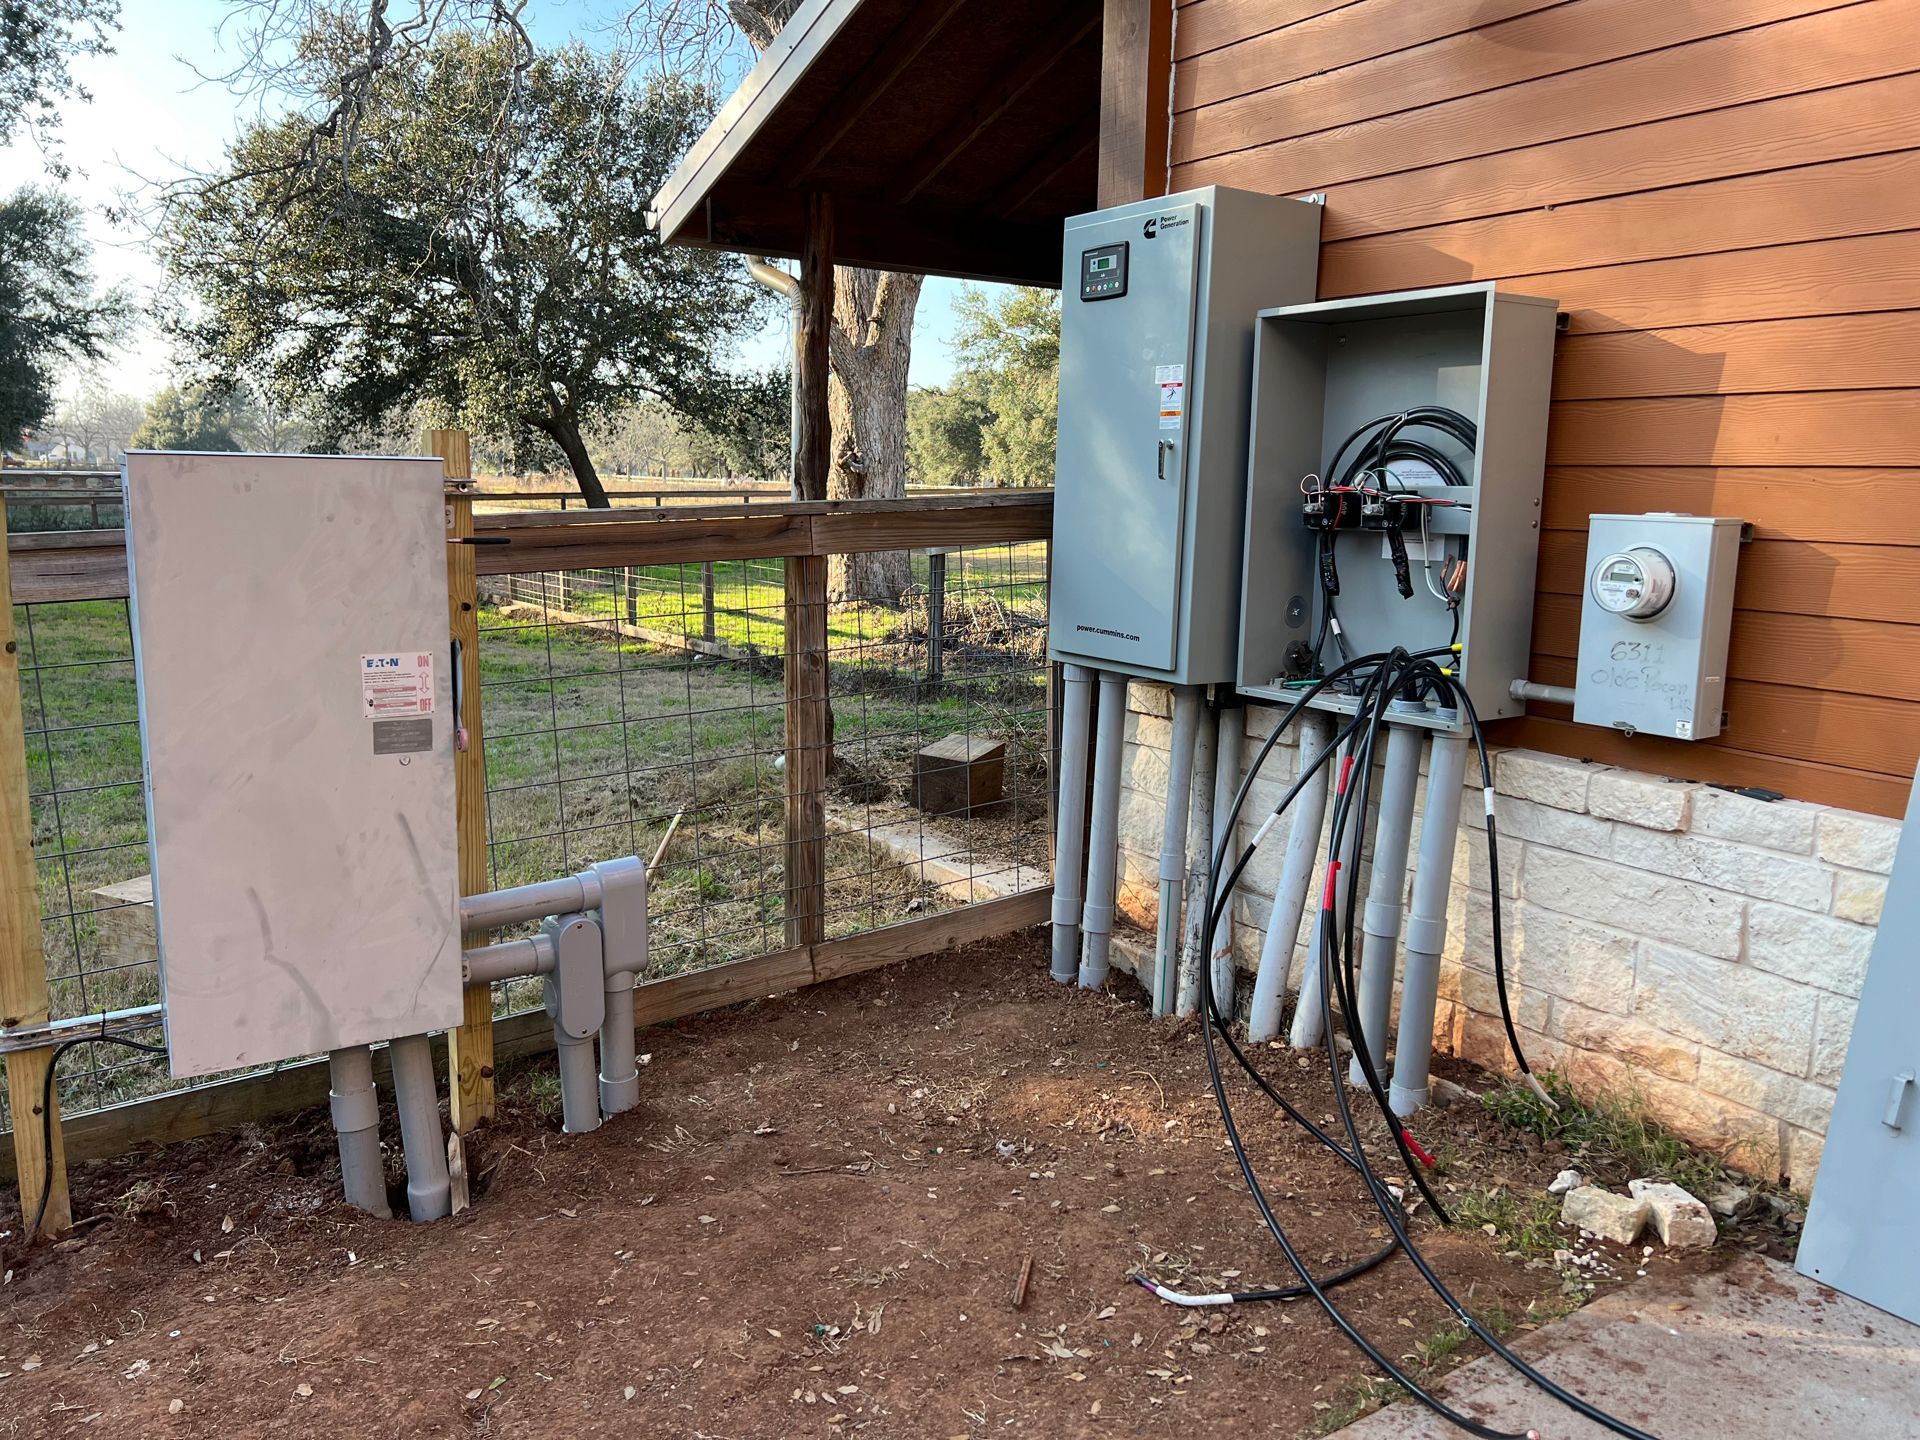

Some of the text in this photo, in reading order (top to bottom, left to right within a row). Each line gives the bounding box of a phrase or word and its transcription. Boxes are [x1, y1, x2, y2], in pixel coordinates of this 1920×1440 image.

[1160, 215, 1177, 223] Power
[1160, 219, 1189, 229] Generation
[1076, 624, 1140, 642] power.cummins.com
[417, 655, 430, 667] ON
[419, 698, 431, 711] OFF
